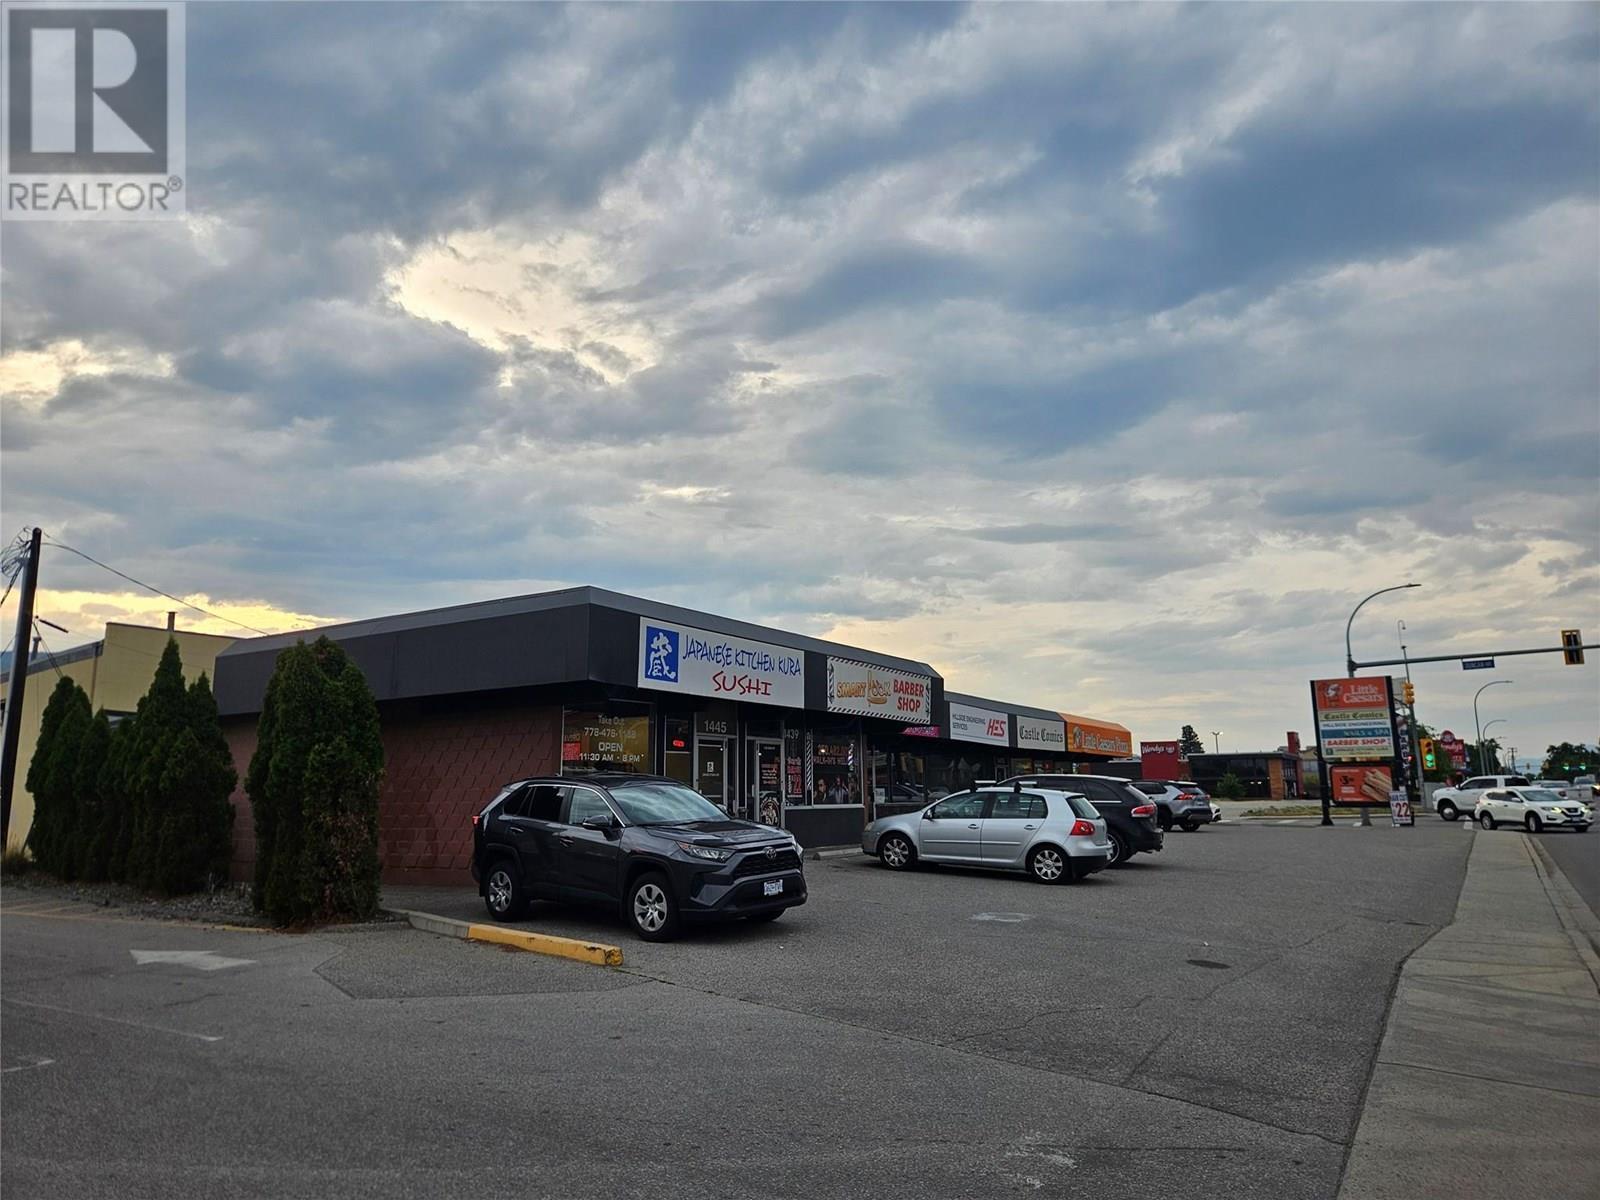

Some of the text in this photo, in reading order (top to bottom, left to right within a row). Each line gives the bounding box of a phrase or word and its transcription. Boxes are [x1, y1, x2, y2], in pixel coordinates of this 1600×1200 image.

[682, 634, 801, 677] JAPANESE KITCHEN KURA
[712, 670, 773, 696] SUSHI
[837, 681, 866, 698] SMART
[893, 679, 924, 697] BARBER
[1351, 684, 1378, 694] Little
[897, 696, 921, 712] SHOP
[1343, 692, 1384, 704] Caesars
[1324, 711, 1350, 720] Castle
[703, 719, 727, 734] 1445
[1374, 728, 1390, 736] SPA
[1019, 725, 1063, 743] Castle Comics
[598, 742, 623, 752] OPEN
[1362, 738, 1387, 746] SHOP
[579, 753, 600, 761] 11:30
[601, 753, 613, 761] AM
[628, 754, 640, 763] PM
